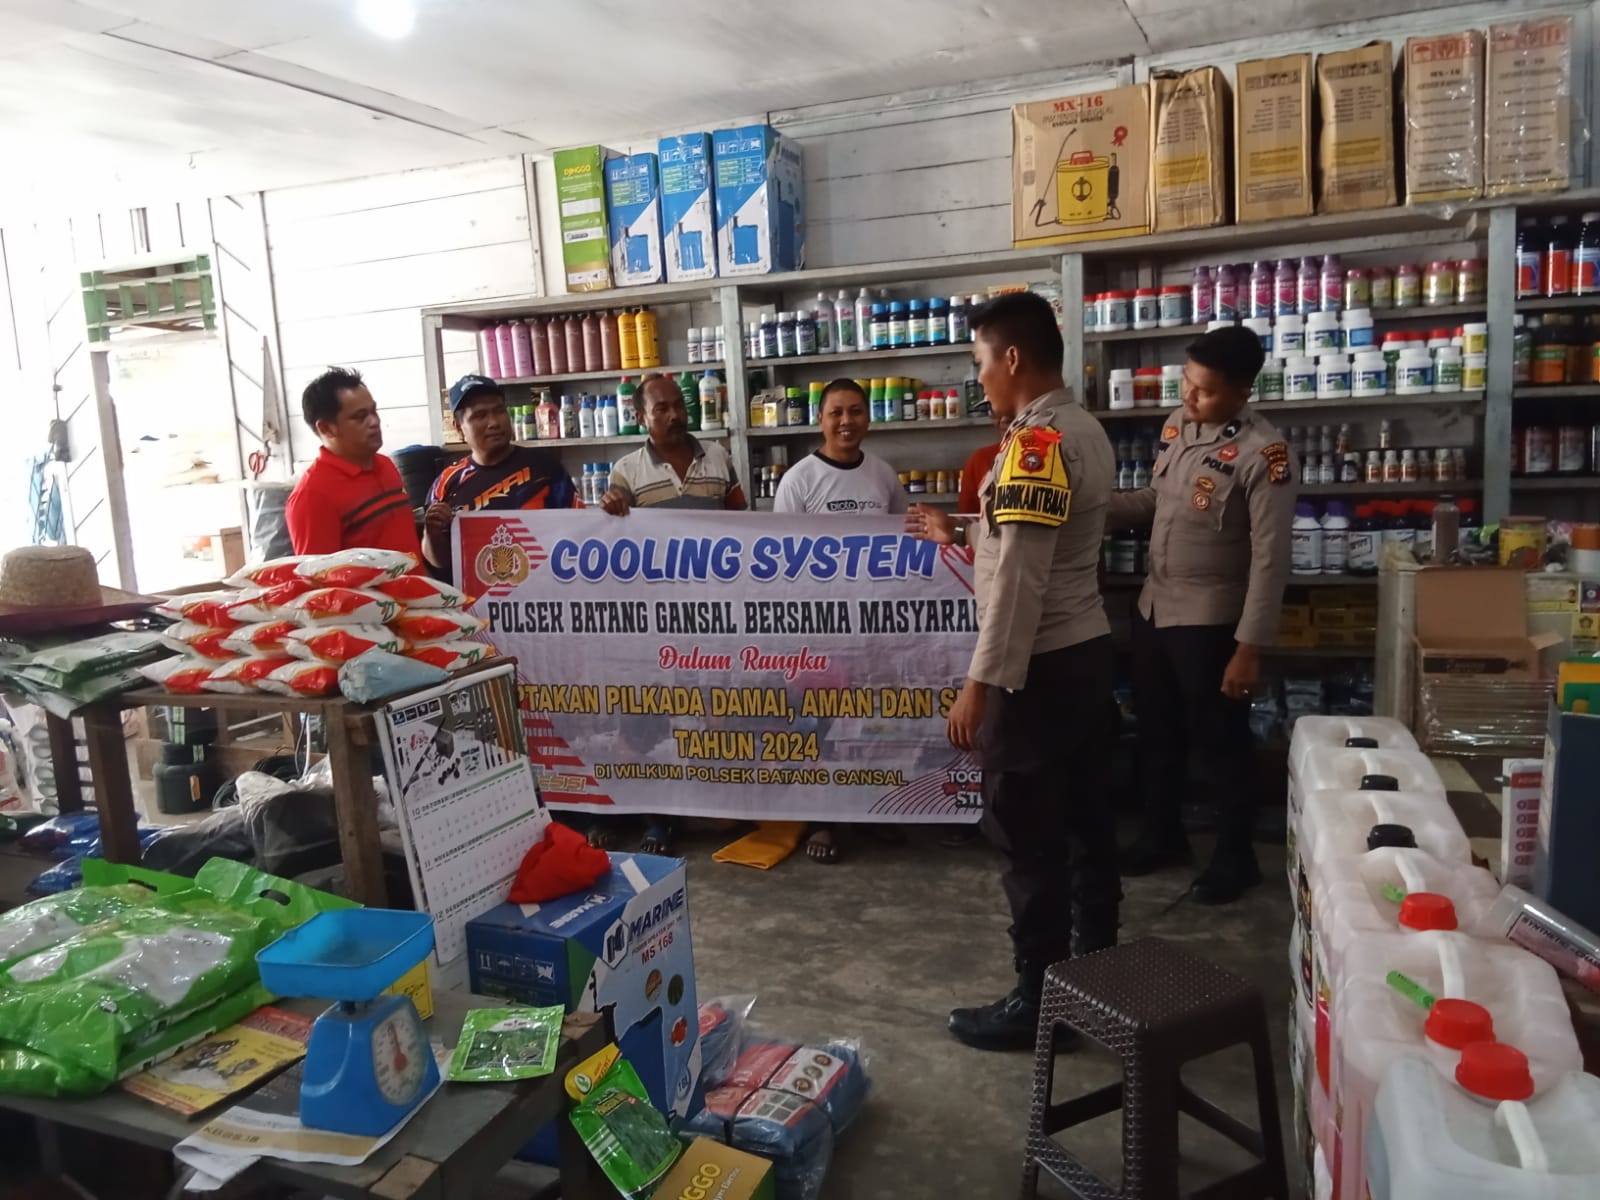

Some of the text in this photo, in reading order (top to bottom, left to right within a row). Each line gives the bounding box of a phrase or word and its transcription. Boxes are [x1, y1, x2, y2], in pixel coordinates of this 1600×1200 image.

[551, 535, 938, 582] COOLING SYSTEM
[488, 602, 564, 633] POLSEK
[570, 602, 648, 633] BATANG
[655, 602, 738, 634] GANSAL
[744, 602, 852, 634] BERSAMA
[658, 645, 830, 680] Dalam Rangka
[606, 686, 705, 716] PILKADA
[711, 687, 795, 722] DAMAI,
[801, 688, 874, 718] AMAN
[880, 688, 931, 718] DAN
[673, 730, 820, 761] TAHUN 2024
[594, 764, 910, 786] DI WILKUM POLSEK BATANG GANSAL
[629, 887, 684, 943] MARINE
[641, 932, 673, 967] MS 168
[679, 1163, 720, 1200] GGO
